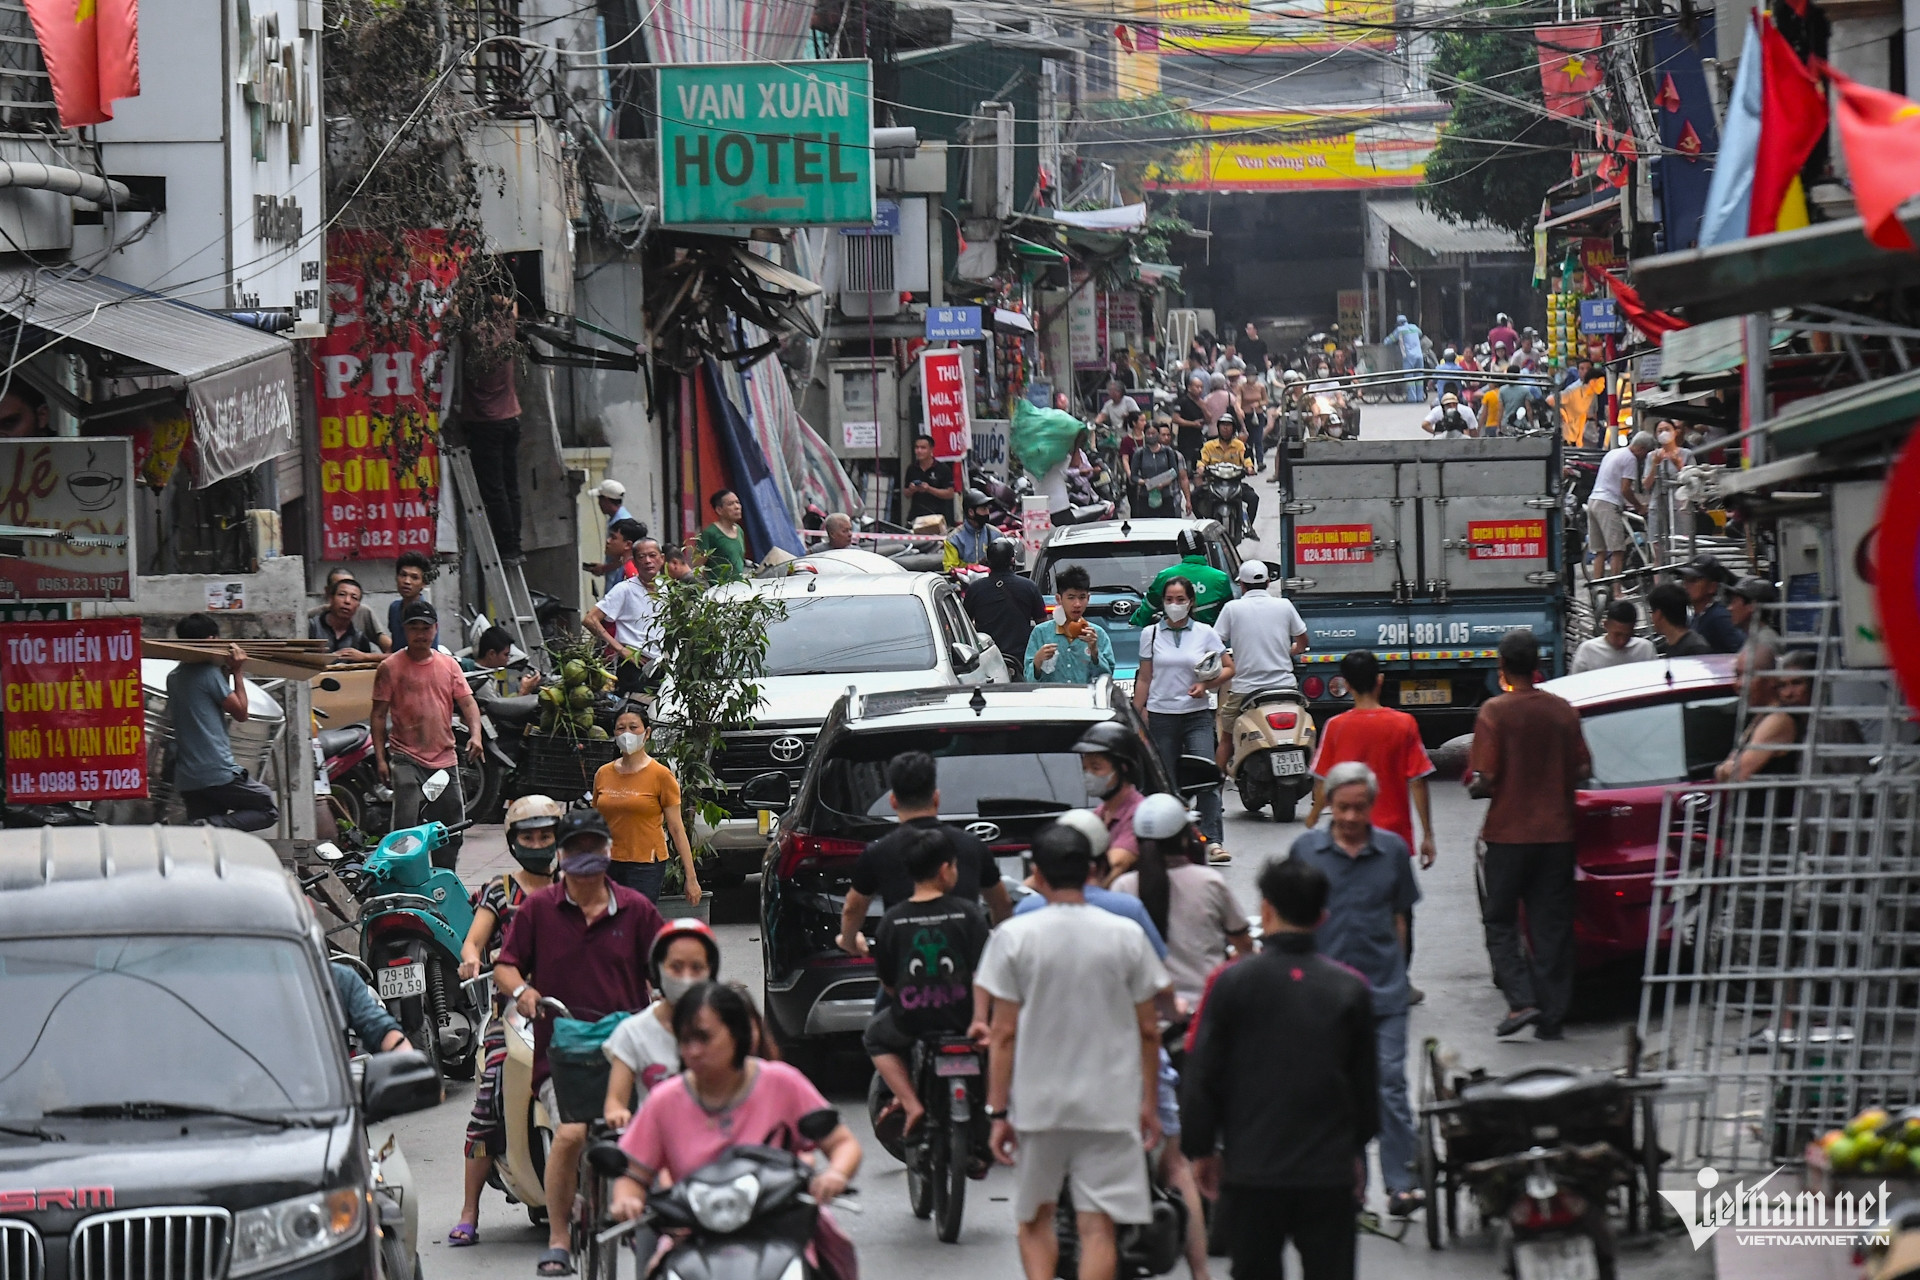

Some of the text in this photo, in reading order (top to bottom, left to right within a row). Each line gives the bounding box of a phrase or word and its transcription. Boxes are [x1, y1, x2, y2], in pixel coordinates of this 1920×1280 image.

[677, 73, 849, 126] VẠN XUÂN
[674, 132, 858, 187] HOTEL
[322, 455, 390, 493] CƠM
[367, 503, 387, 520] 31
[37, 576, 124, 592] 0963.23.1967
[8, 628, 133, 665] TÓC HIỀN VŨ
[1377, 622, 1471, 646] 29H-881.05
[6, 668, 103, 713] CHUYỂN
[46, 729, 65, 758] 14
[68, 727, 101, 763] VẠN
[105, 715, 141, 756] KIẾP
[12, 768, 140, 794] LH: 0988 55 7028
[381, 980, 423, 997] 002.59
[384, 965, 417, 983] 29-BK
